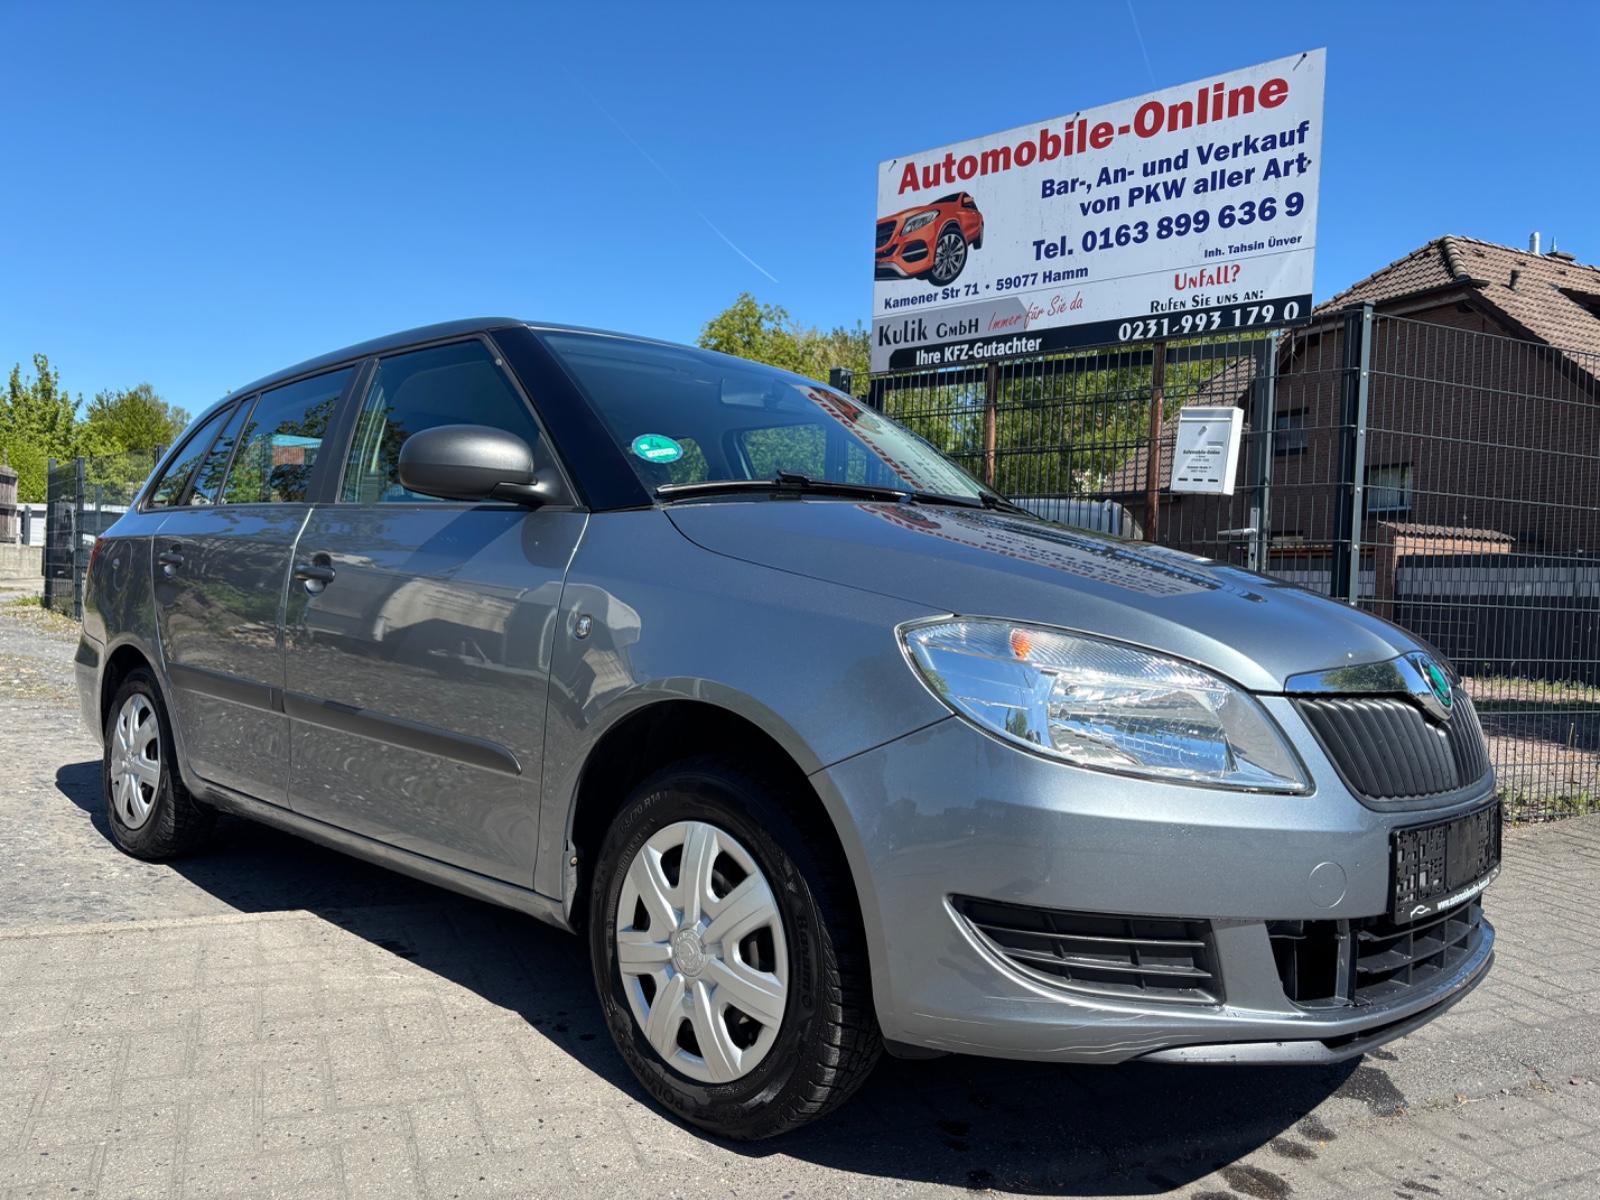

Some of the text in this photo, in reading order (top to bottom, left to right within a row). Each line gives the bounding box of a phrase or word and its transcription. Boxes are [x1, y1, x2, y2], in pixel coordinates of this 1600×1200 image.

[898, 77, 1289, 195] Automobile-Online
[1041, 120, 1310, 199] Bar-, An- und Verkauf
[1080, 151, 1308, 216] von PKW aller Art
[1032, 191, 1305, 261] Tel. 0163 899 636 9
[1204, 235, 1303, 259] Inh. Tahsin Ünver
[884, 267, 1089, 310] Kamener Str 71 59077 Hamm
[878, 317, 928, 347] Kulik
[987, 291, 1084, 332] Immer für Sie da
[1118, 301, 1300, 342] 0231-993 179 0
[915, 336, 1043, 366] Ihre KFZ-Gutachter
